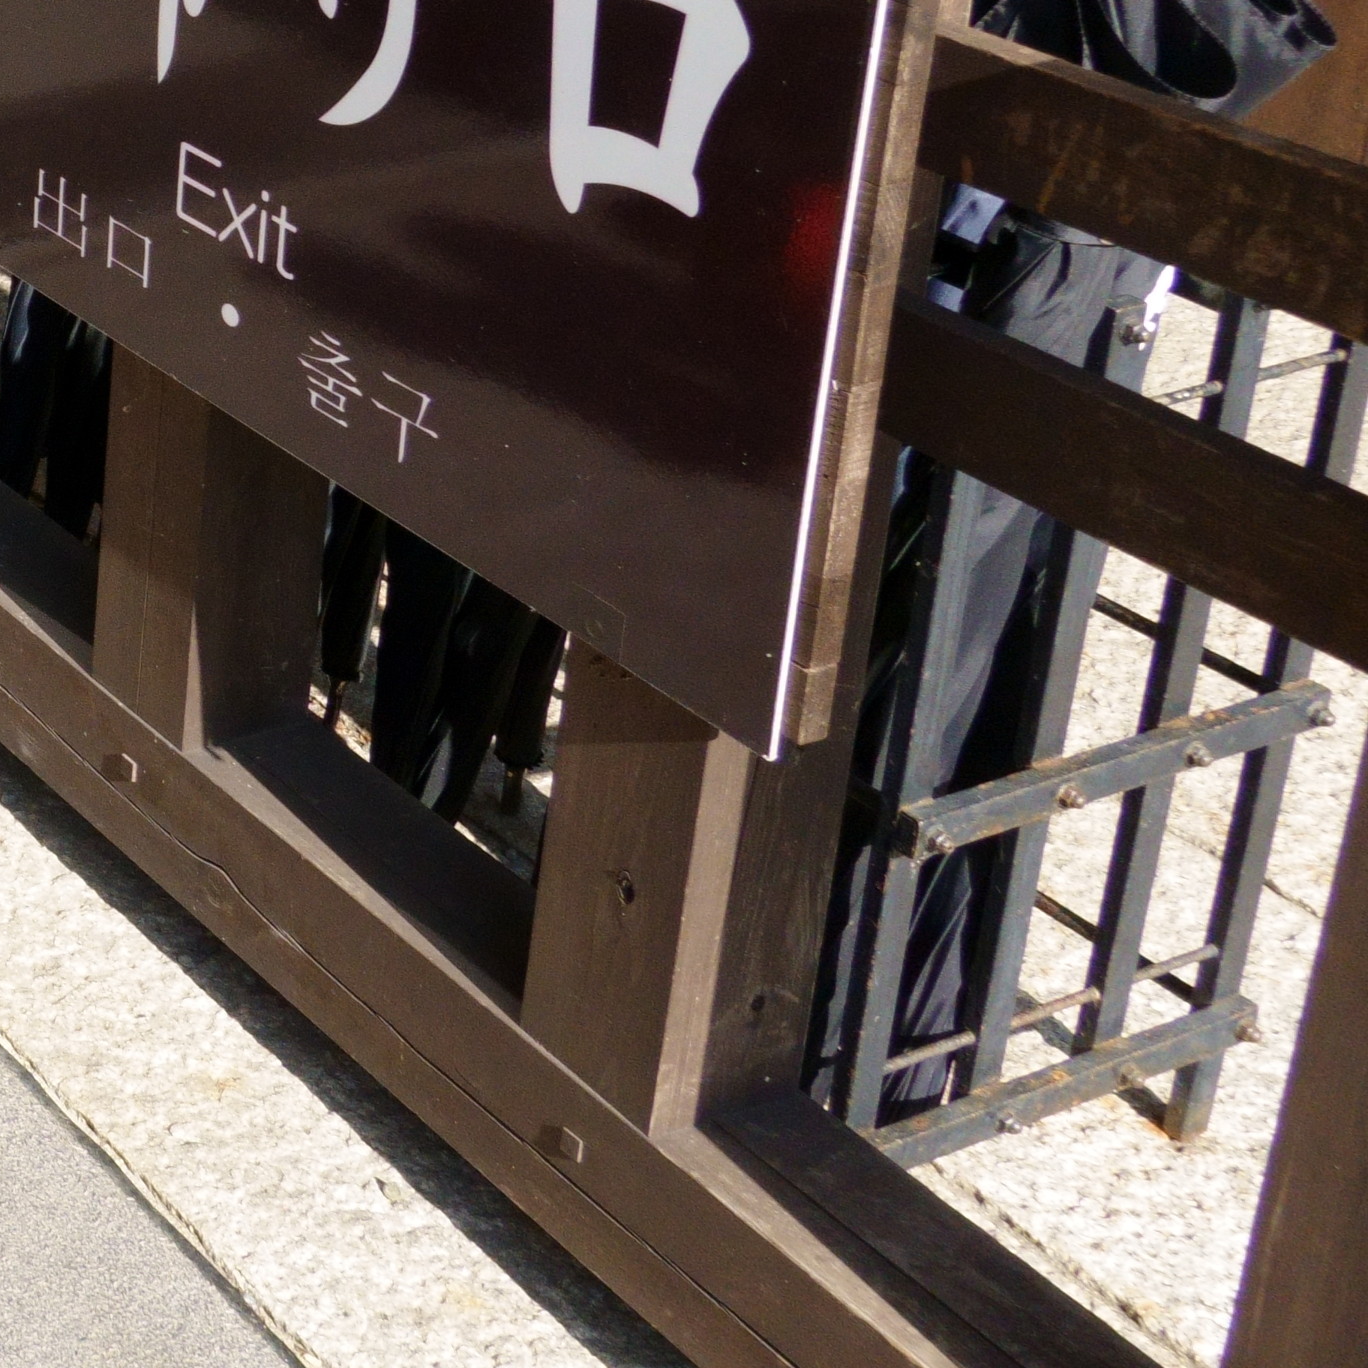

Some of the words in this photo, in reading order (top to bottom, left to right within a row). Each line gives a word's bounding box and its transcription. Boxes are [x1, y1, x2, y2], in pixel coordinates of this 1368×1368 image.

[32, 166, 154, 290] 出口
[173, 139, 298, 282] Exit
[297, 330, 439, 465] 출구
